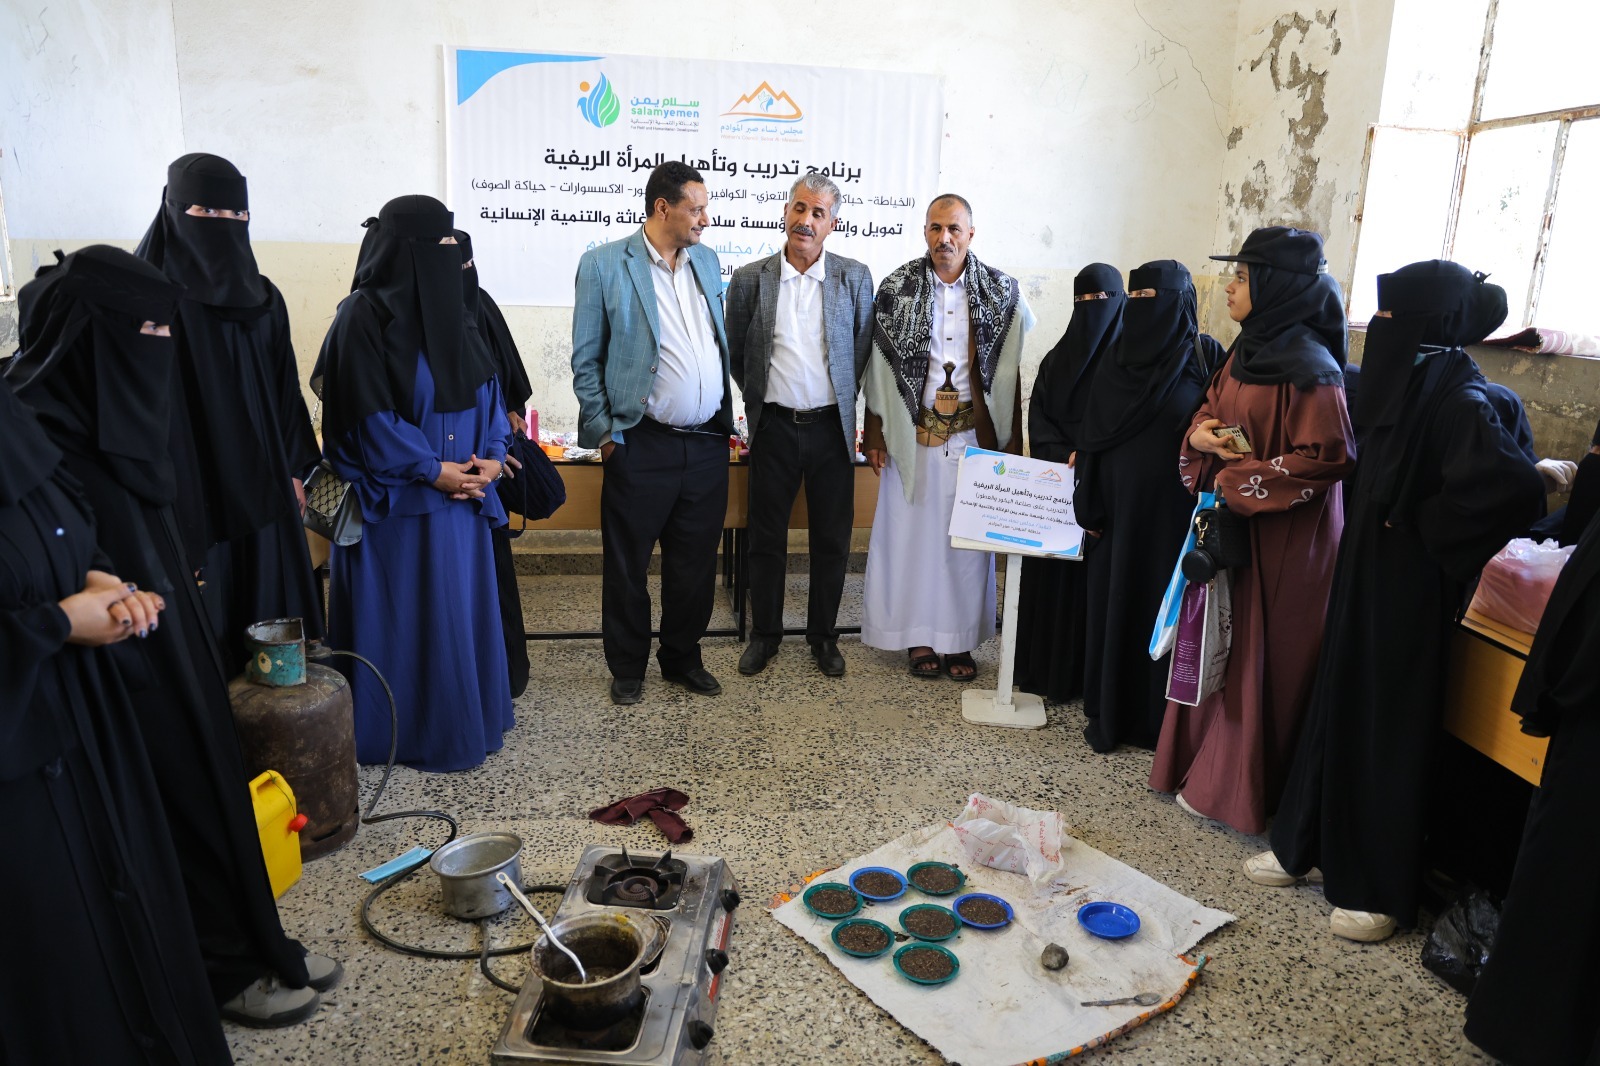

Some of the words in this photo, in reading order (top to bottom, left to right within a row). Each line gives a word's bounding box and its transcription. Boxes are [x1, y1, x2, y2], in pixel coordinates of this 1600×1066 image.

[630, 96, 660, 107] يمن
[662, 97, 699, 108] سلام
[631, 106, 699, 118] salamyemen
[761, 124, 777, 133] نساء
[780, 126, 803, 136] مجلس
[544, 148, 610, 172] الريفية
[616, 144, 665, 173] المرأة
[743, 159, 800, 179] تدريب
[514, 180, 547, 193] حياكة
[480, 206, 545, 227] الإنسانية
[550, 208, 611, 227] والتنمية
[710, 214, 736, 228] سلا
[740, 216, 786, 234] ؤسسة
[833, 217, 858, 238] وإش
[862, 222, 903, 238] تمويل
[973, 480, 995, 490] الريفية
[1011, 488, 1033, 499] وتأهيل
[1015, 499, 1031, 508] صناعة
[1032, 503, 1045, 511] على
[1052, 497, 1072, 506] برنامج
